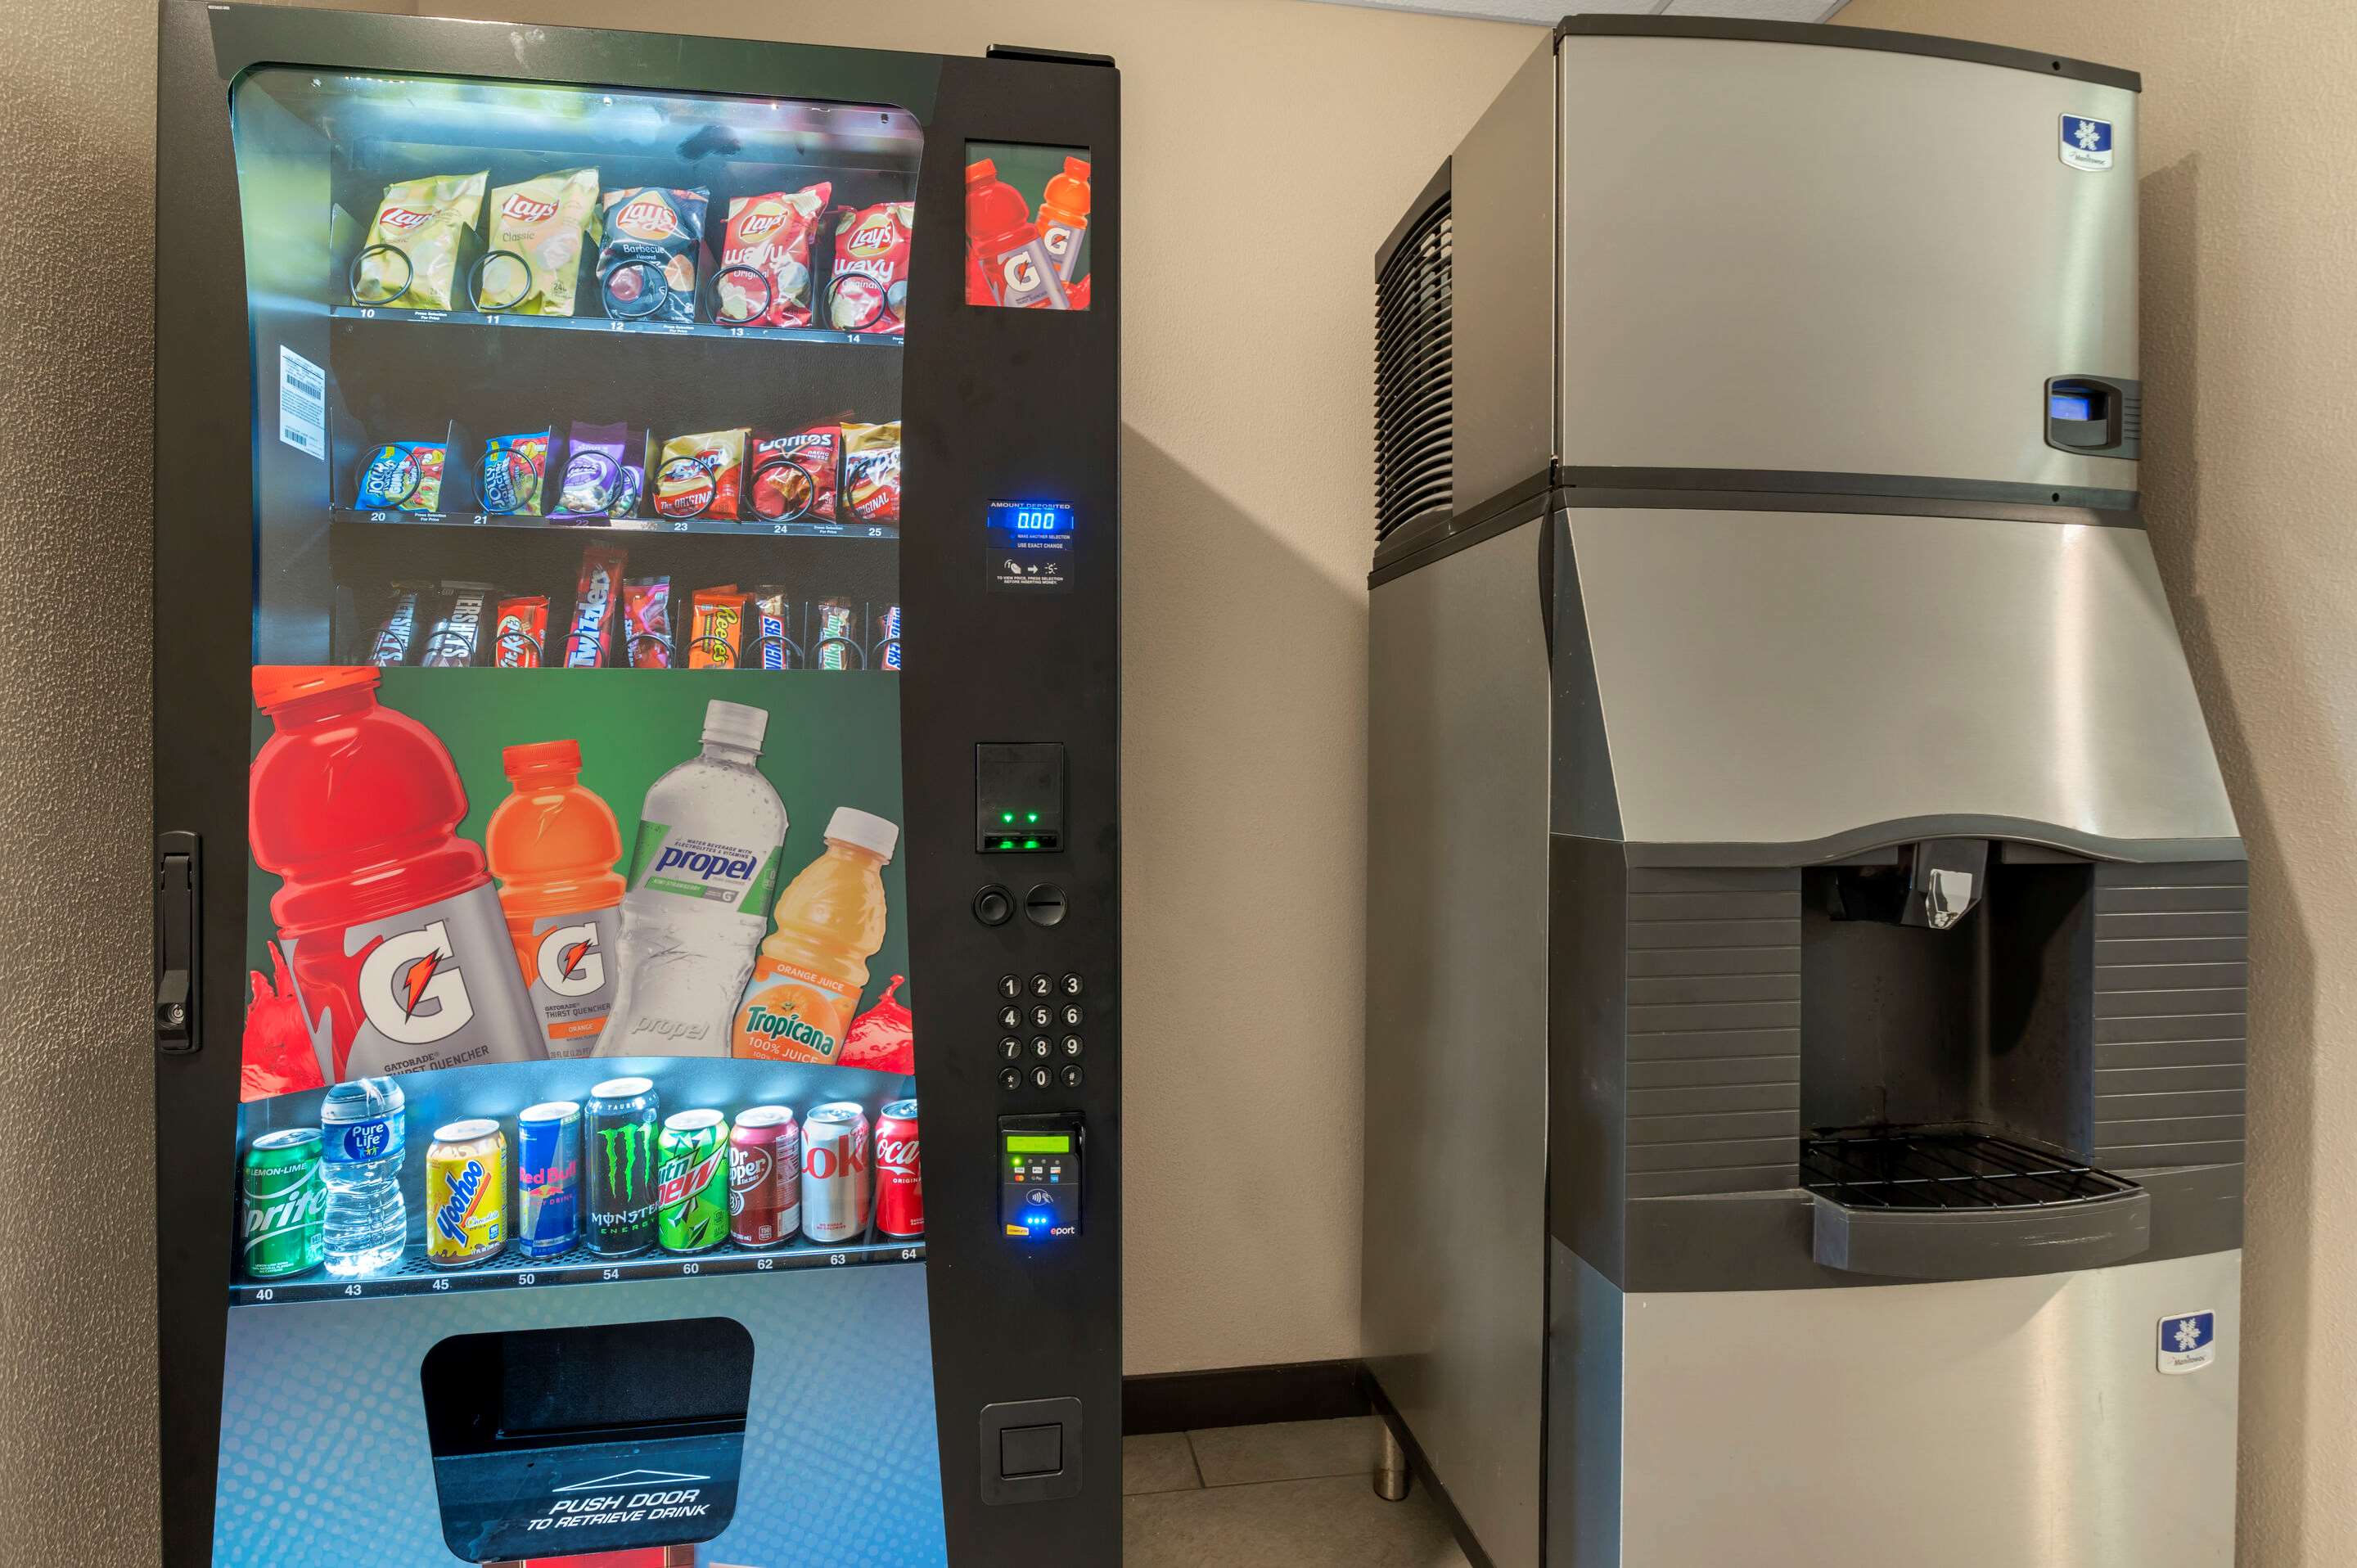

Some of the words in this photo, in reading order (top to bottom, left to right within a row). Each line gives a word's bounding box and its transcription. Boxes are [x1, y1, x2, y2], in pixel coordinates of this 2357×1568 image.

[623, 244, 665, 254] Barbecue
[834, 259, 894, 283] wavy
[360, 309, 375, 318] 10
[487, 315, 499, 323] 11
[611, 322, 624, 330] 12
[847, 335, 860, 343] 14
[371, 512, 386, 521] 20
[474, 516, 488, 525] 21
[674, 522, 687, 531] 23
[774, 525, 787, 534] 24
[868, 528, 882, 537] 25
[674, 841, 716, 853] ELECTROLYTES
[723, 850, 749, 859] VITAMINS
[707, 841, 737, 853] BEVERAGE
[655, 846, 758, 881] propel
[722, 891, 735, 902] G
[537, 921, 606, 997] G
[358, 919, 475, 1045] G
[777, 963, 818, 982] ORANGE
[818, 974, 845, 992] JUICE
[1006, 980, 1013, 995] 1
[1037, 979, 1047, 994] 2
[1067, 978, 1078, 993] 3
[545, 1009, 570, 1019] THIRST
[573, 1003, 611, 1016] QUENCHER
[1005, 1010, 1015, 1025] 4
[1037, 1009, 1047, 1024] 5
[1067, 1008, 1077, 1024] 6
[568, 1023, 594, 1032] ORANGE
[632, 1017, 710, 1041] propel
[746, 1006, 834, 1056] Tropicana
[749, 1037, 781, 1054] 100%
[782, 1048, 818, 1063] JUICE
[1006, 1042, 1015, 1057] 7
[1037, 1040, 1046, 1056] 8
[1067, 1039, 1078, 1054] 9
[430, 1044, 489, 1070] QUENCHER
[1036, 1070, 1046, 1085] 0
[353, 1124, 384, 1138] Pure
[356, 1134, 381, 1148] Life
[730, 1147, 749, 1168] Dr
[251, 1162, 307, 1176] LEMON-LIME
[520, 1168, 544, 1185] Red
[548, 1160, 577, 1183] Bull
[730, 1158, 766, 1187] pper
[600, 1216, 656, 1235] ENERGY
[1050, 1226, 1075, 1237] eport
[831, 1255, 845, 1265] 63
[902, 1249, 917, 1259] 64
[683, 1263, 699, 1274] 60
[758, 1259, 773, 1270] 62
[519, 1274, 534, 1285] 50
[603, 1269, 619, 1280] 54
[345, 1284, 362, 1295] 43
[433, 1279, 449, 1290] 45
[256, 1289, 273, 1300] 40
[548, 1495, 623, 1515] PUSH
[627, 1489, 701, 1508] DOOR
[527, 1518, 553, 1531] TO
[556, 1510, 646, 1529] RETRIEVE
[647, 1503, 710, 1519] DRINK
